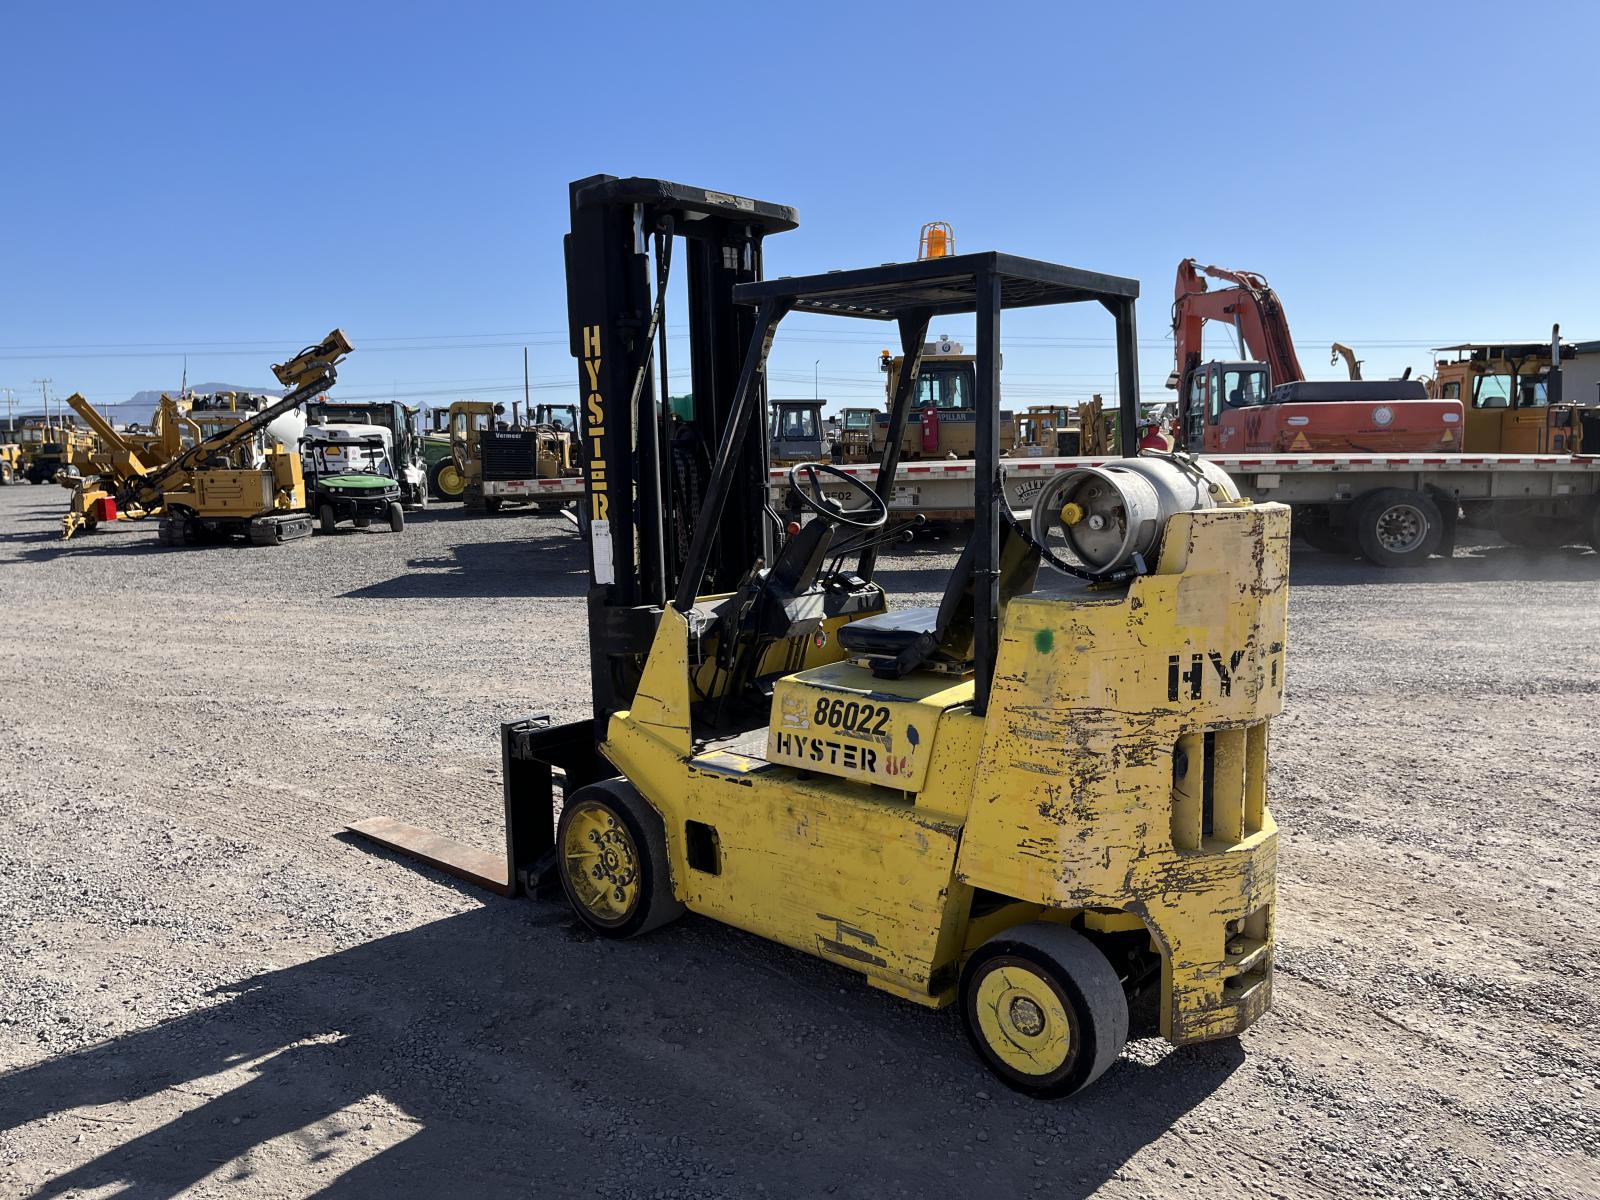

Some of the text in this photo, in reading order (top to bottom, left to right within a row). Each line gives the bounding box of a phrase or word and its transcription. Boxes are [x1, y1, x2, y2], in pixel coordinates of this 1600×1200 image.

[583, 325, 609, 520] HYSTER
[814, 696, 891, 737] 86022
[777, 732, 877, 773] HYSTER
